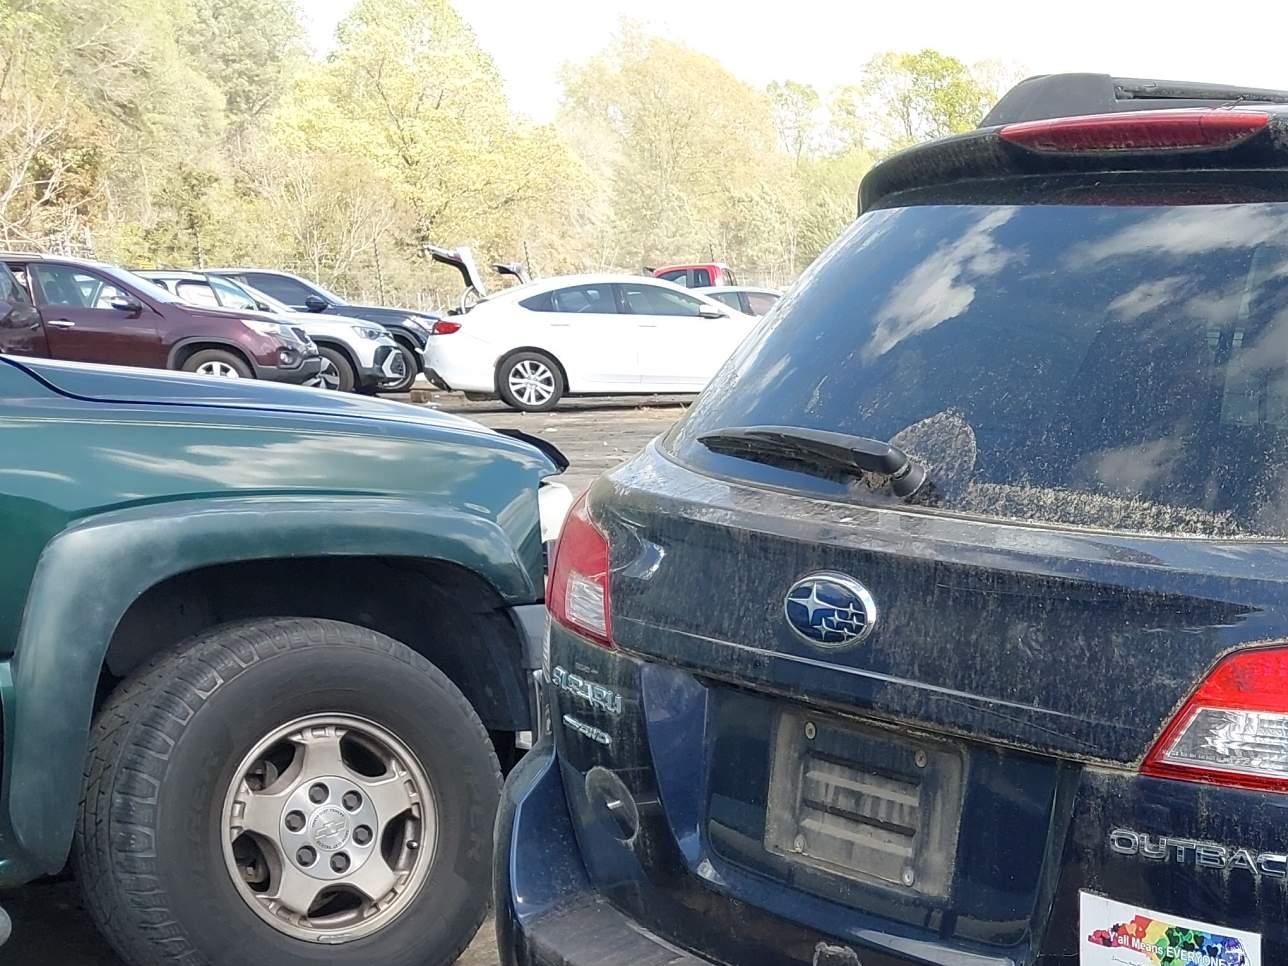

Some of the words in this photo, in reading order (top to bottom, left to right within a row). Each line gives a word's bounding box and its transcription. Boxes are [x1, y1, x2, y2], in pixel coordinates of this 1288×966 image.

[552, 665, 623, 714] SUBARU
[1108, 930, 1130, 947] Y'all
[1131, 936, 1164, 955] Means
